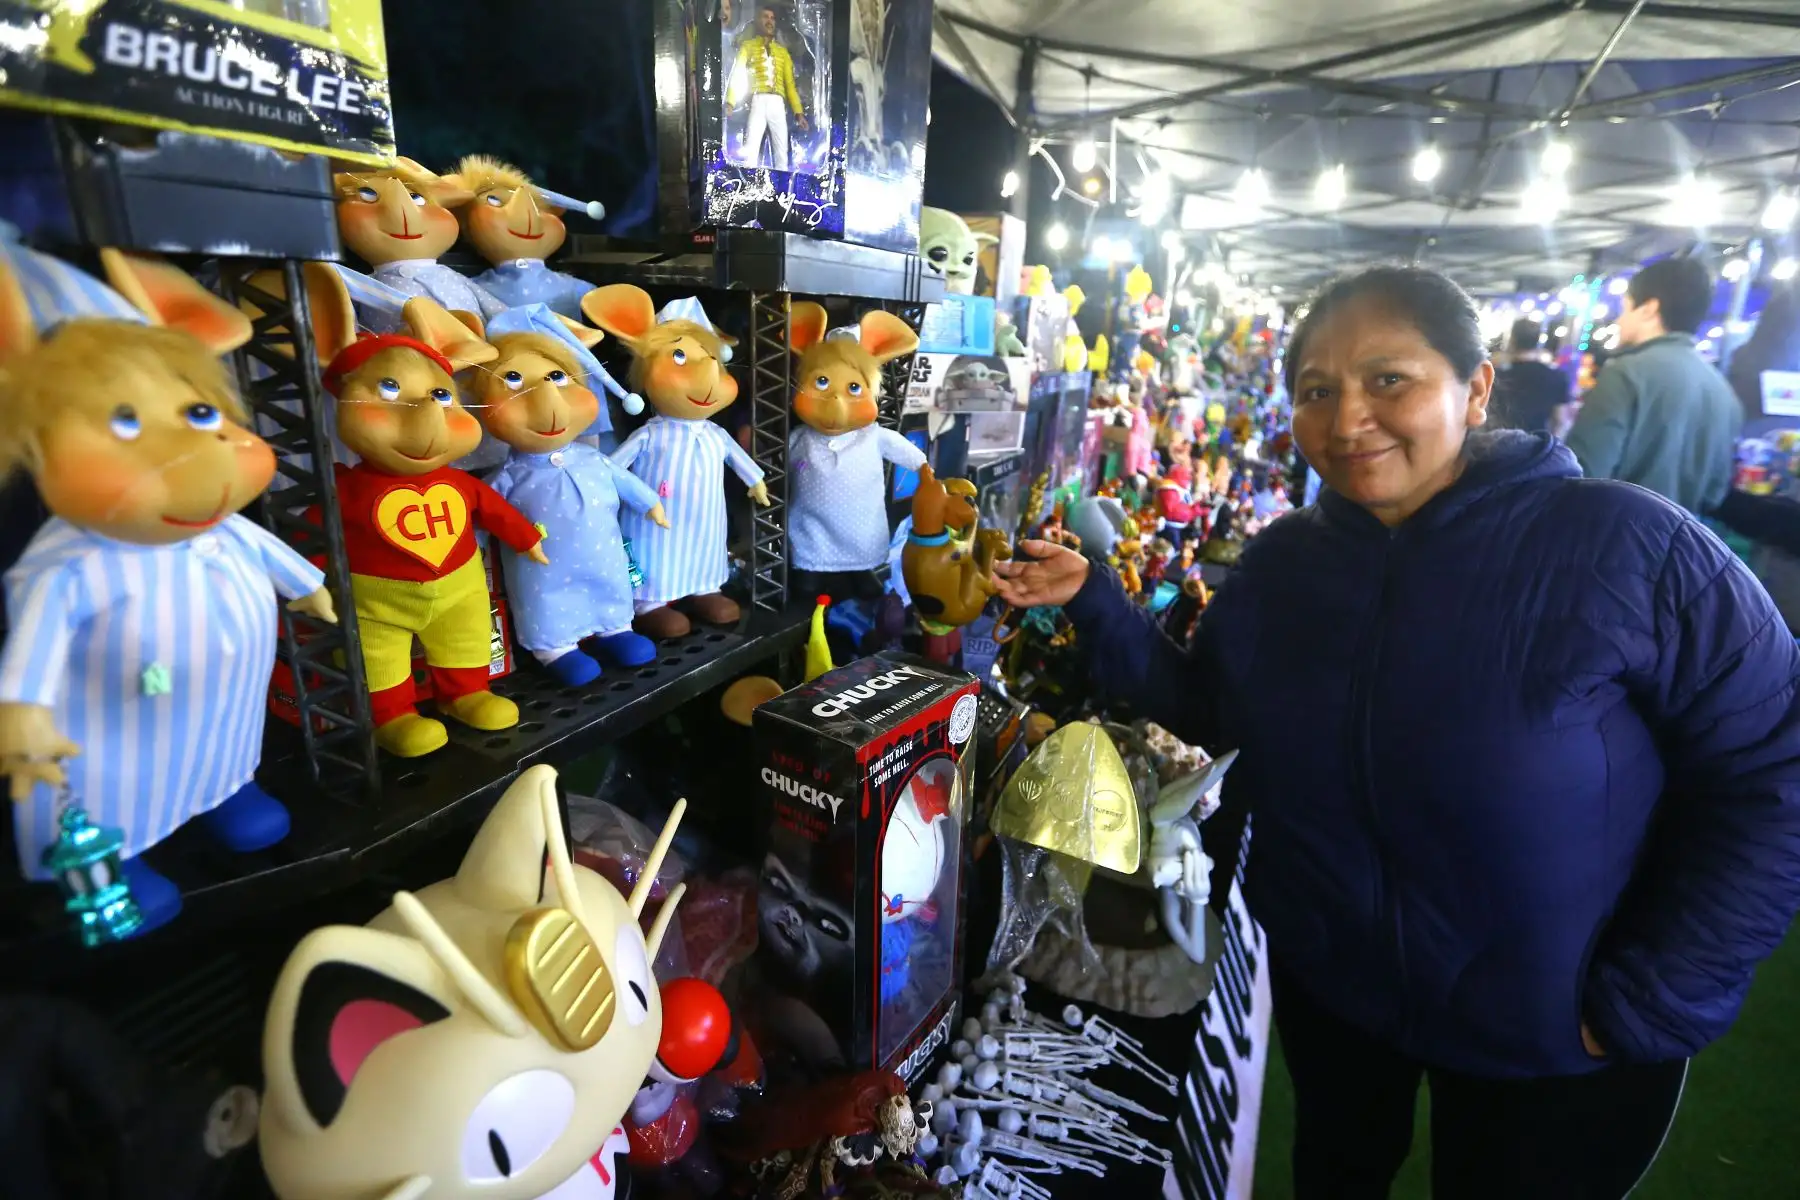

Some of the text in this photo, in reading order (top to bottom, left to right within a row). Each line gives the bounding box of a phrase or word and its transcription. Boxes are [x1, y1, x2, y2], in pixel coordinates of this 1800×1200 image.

[104, 22, 362, 114] BRUCE LEE
[248, 101, 306, 126] FIGURE
[396, 501, 454, 541] CH
[811, 666, 935, 718] CHUCKY
[865, 712, 886, 725] TIME
[881, 708, 894, 716] TO
[891, 698, 913, 711] RAISE
[908, 689, 929, 701] SOME
[869, 740, 913, 776] TIME TO RAISE
[874, 758, 909, 788] SOME HELL.
[760, 767, 845, 825] CHUCKY
